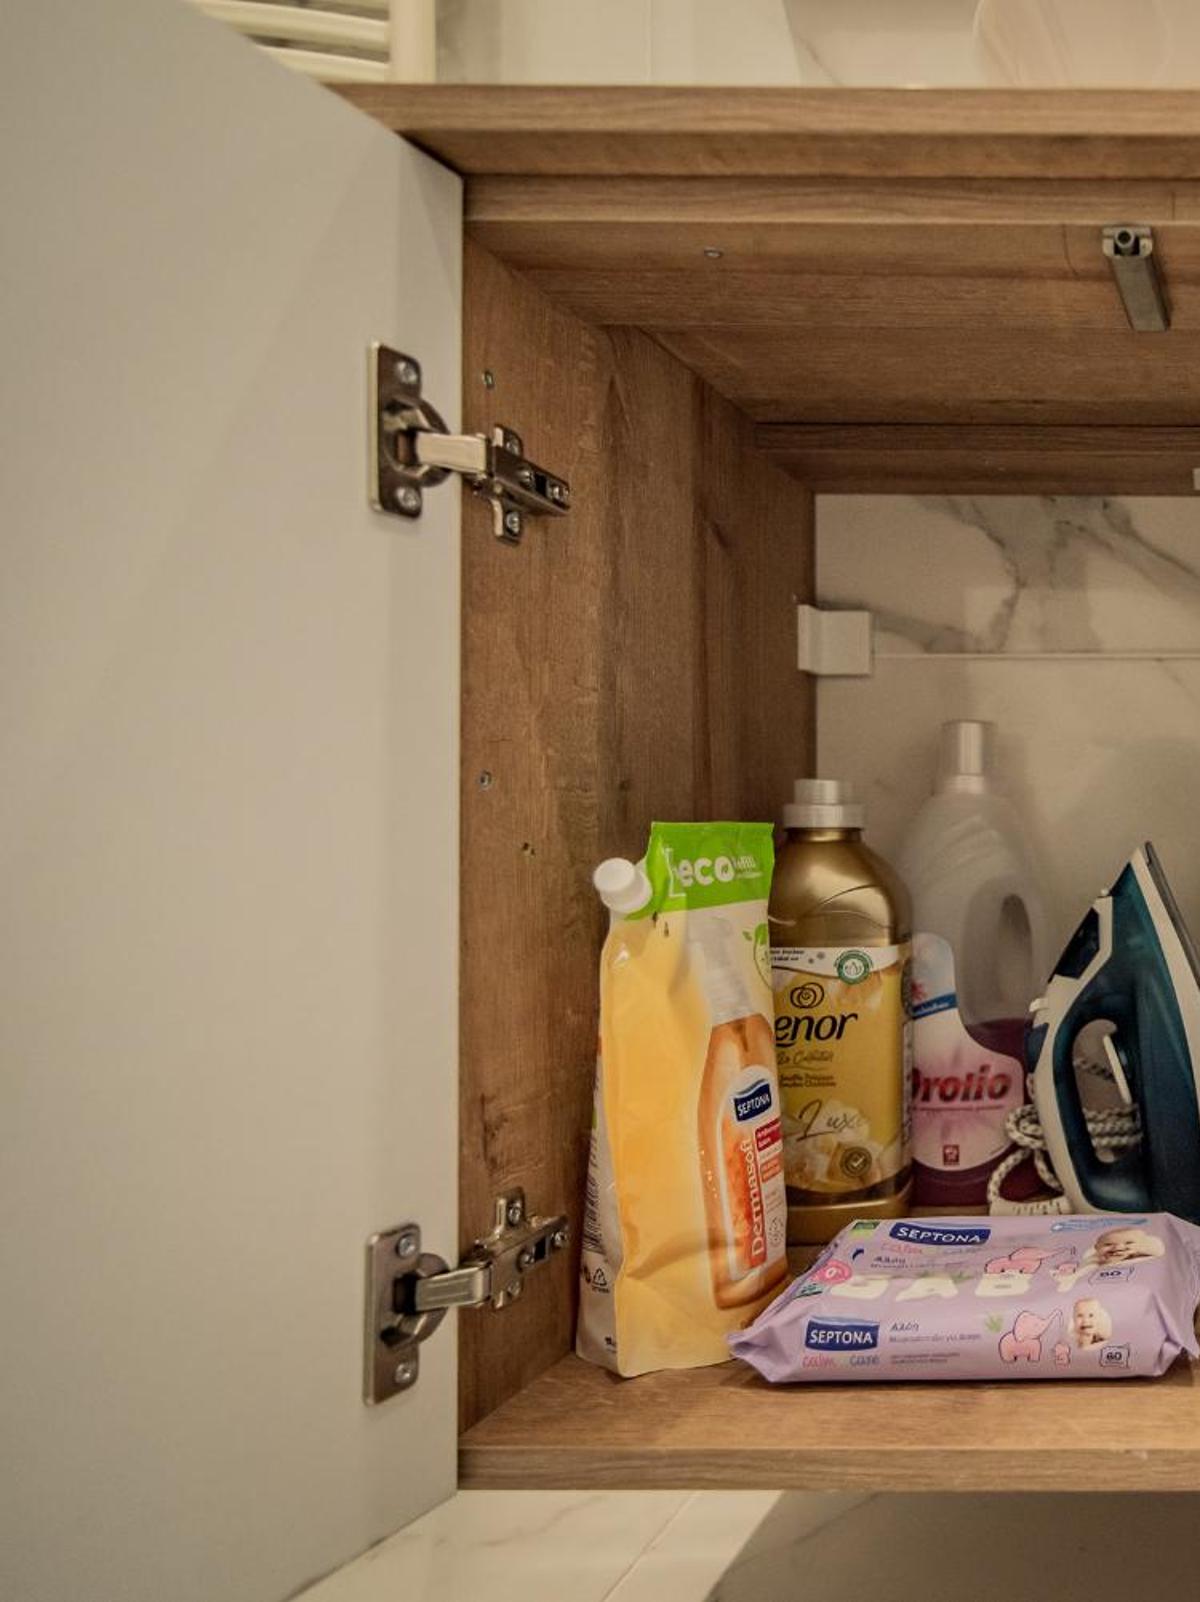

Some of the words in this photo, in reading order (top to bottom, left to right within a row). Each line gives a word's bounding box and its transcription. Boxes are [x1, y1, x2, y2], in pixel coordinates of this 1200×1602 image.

[678, 855, 735, 887] eco
[774, 1012, 858, 1043] enor
[737, 1092, 770, 1117] SEPTONA
[896, 1226, 982, 1244] SEPTONA
[809, 1329, 874, 1345] SEPTONA
[1107, 1351, 1122, 1361] 60
